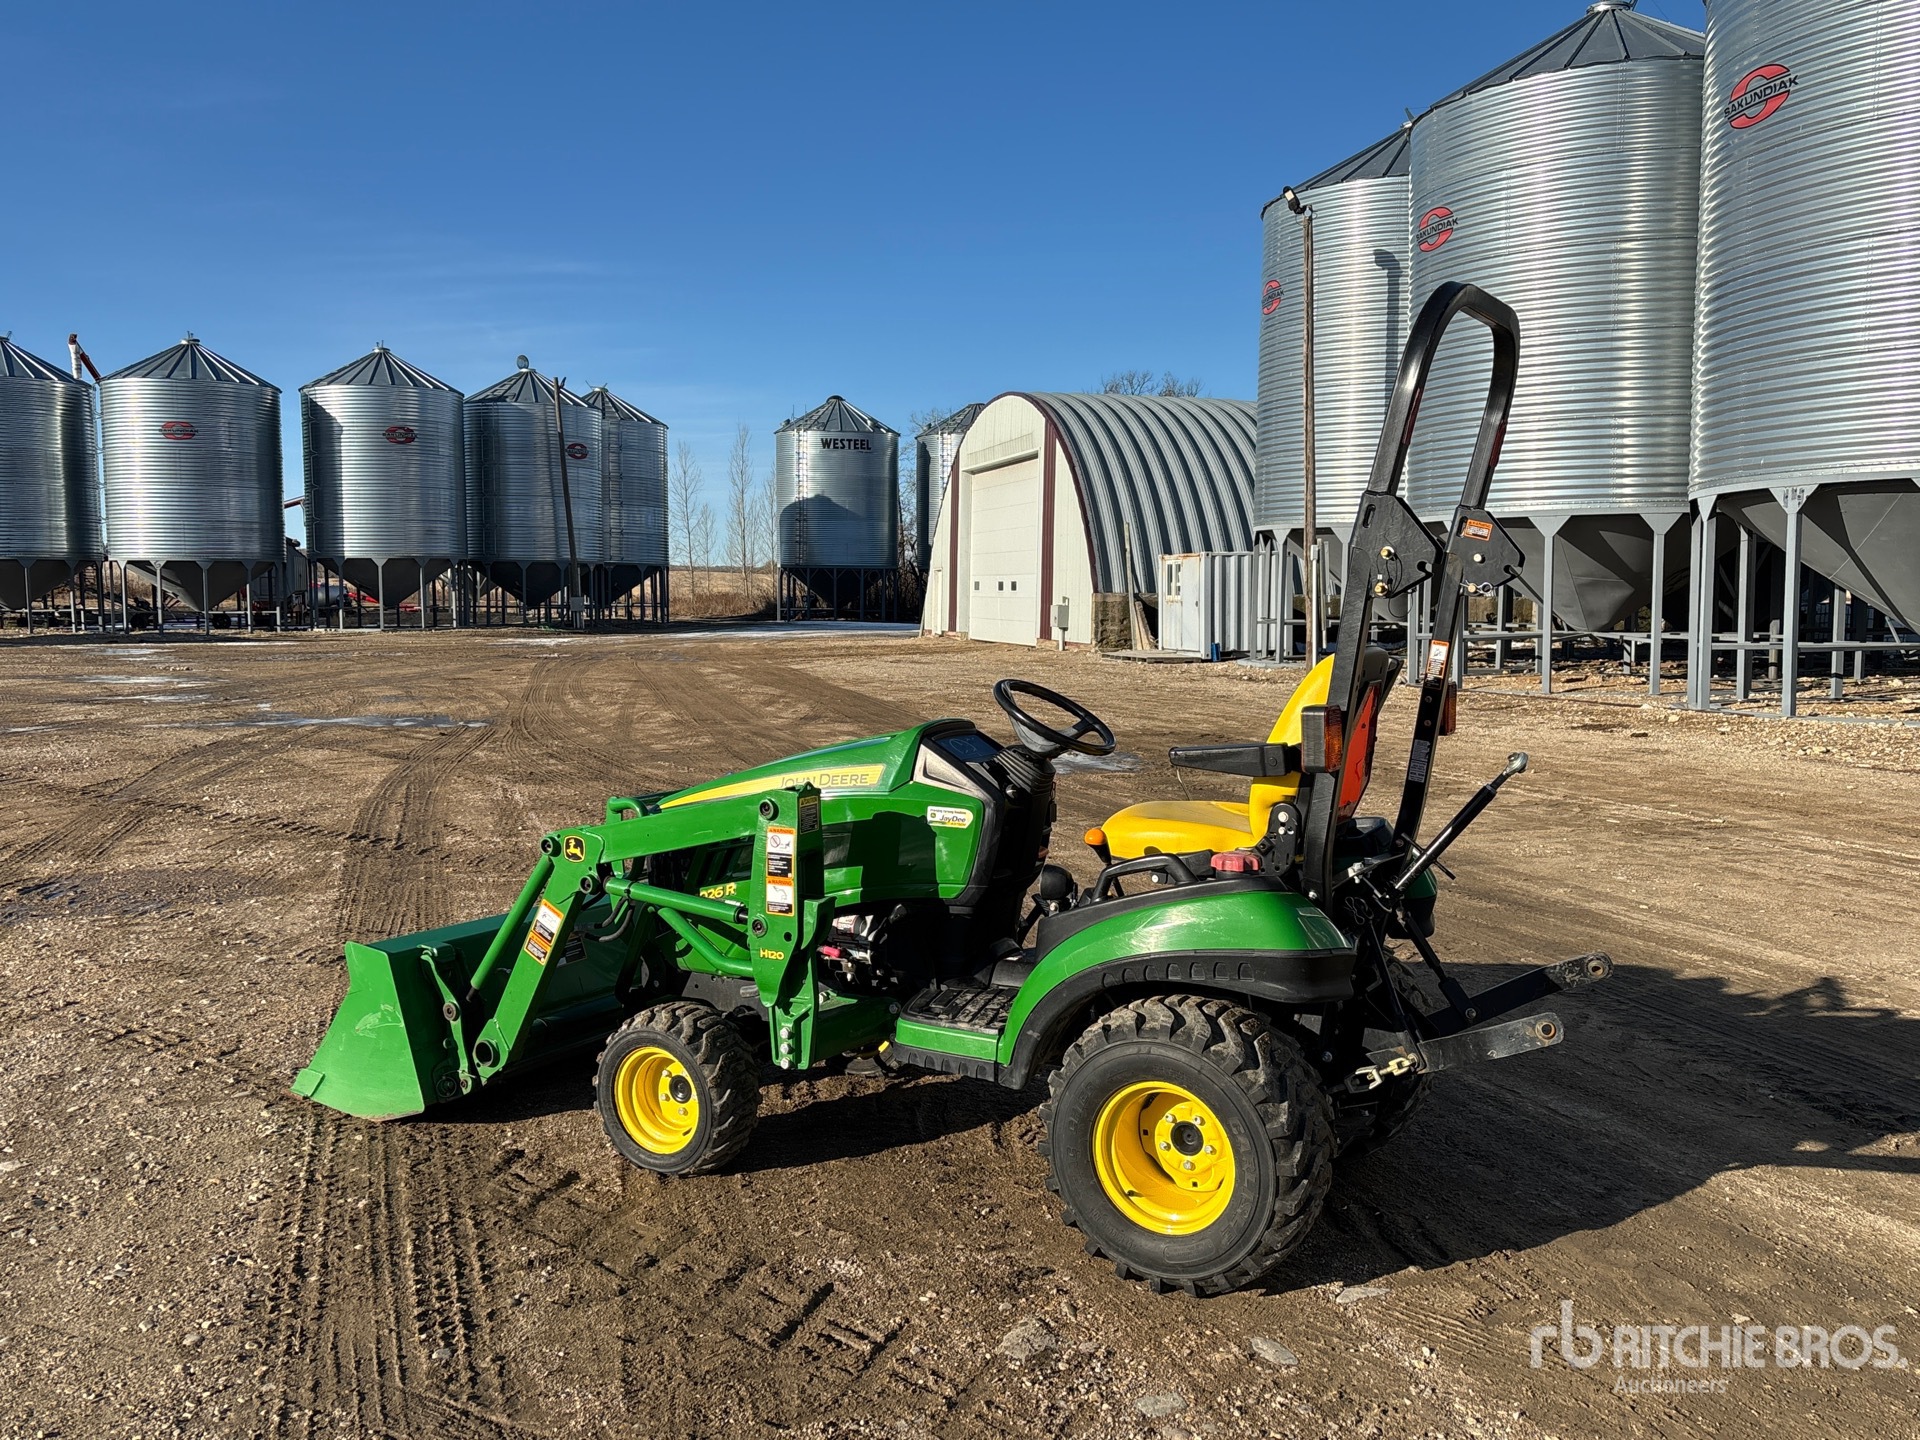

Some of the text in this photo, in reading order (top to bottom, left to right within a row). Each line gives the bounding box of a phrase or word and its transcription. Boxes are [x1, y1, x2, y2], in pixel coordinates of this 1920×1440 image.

[1723, 75, 1799, 118] SAKUNDIAK
[1416, 217, 1459, 241] SAKUNDIAK
[821, 438, 872, 450] WESTEEL
[820, 773, 870, 786] DEERE
[760, 948, 785, 960] H120
